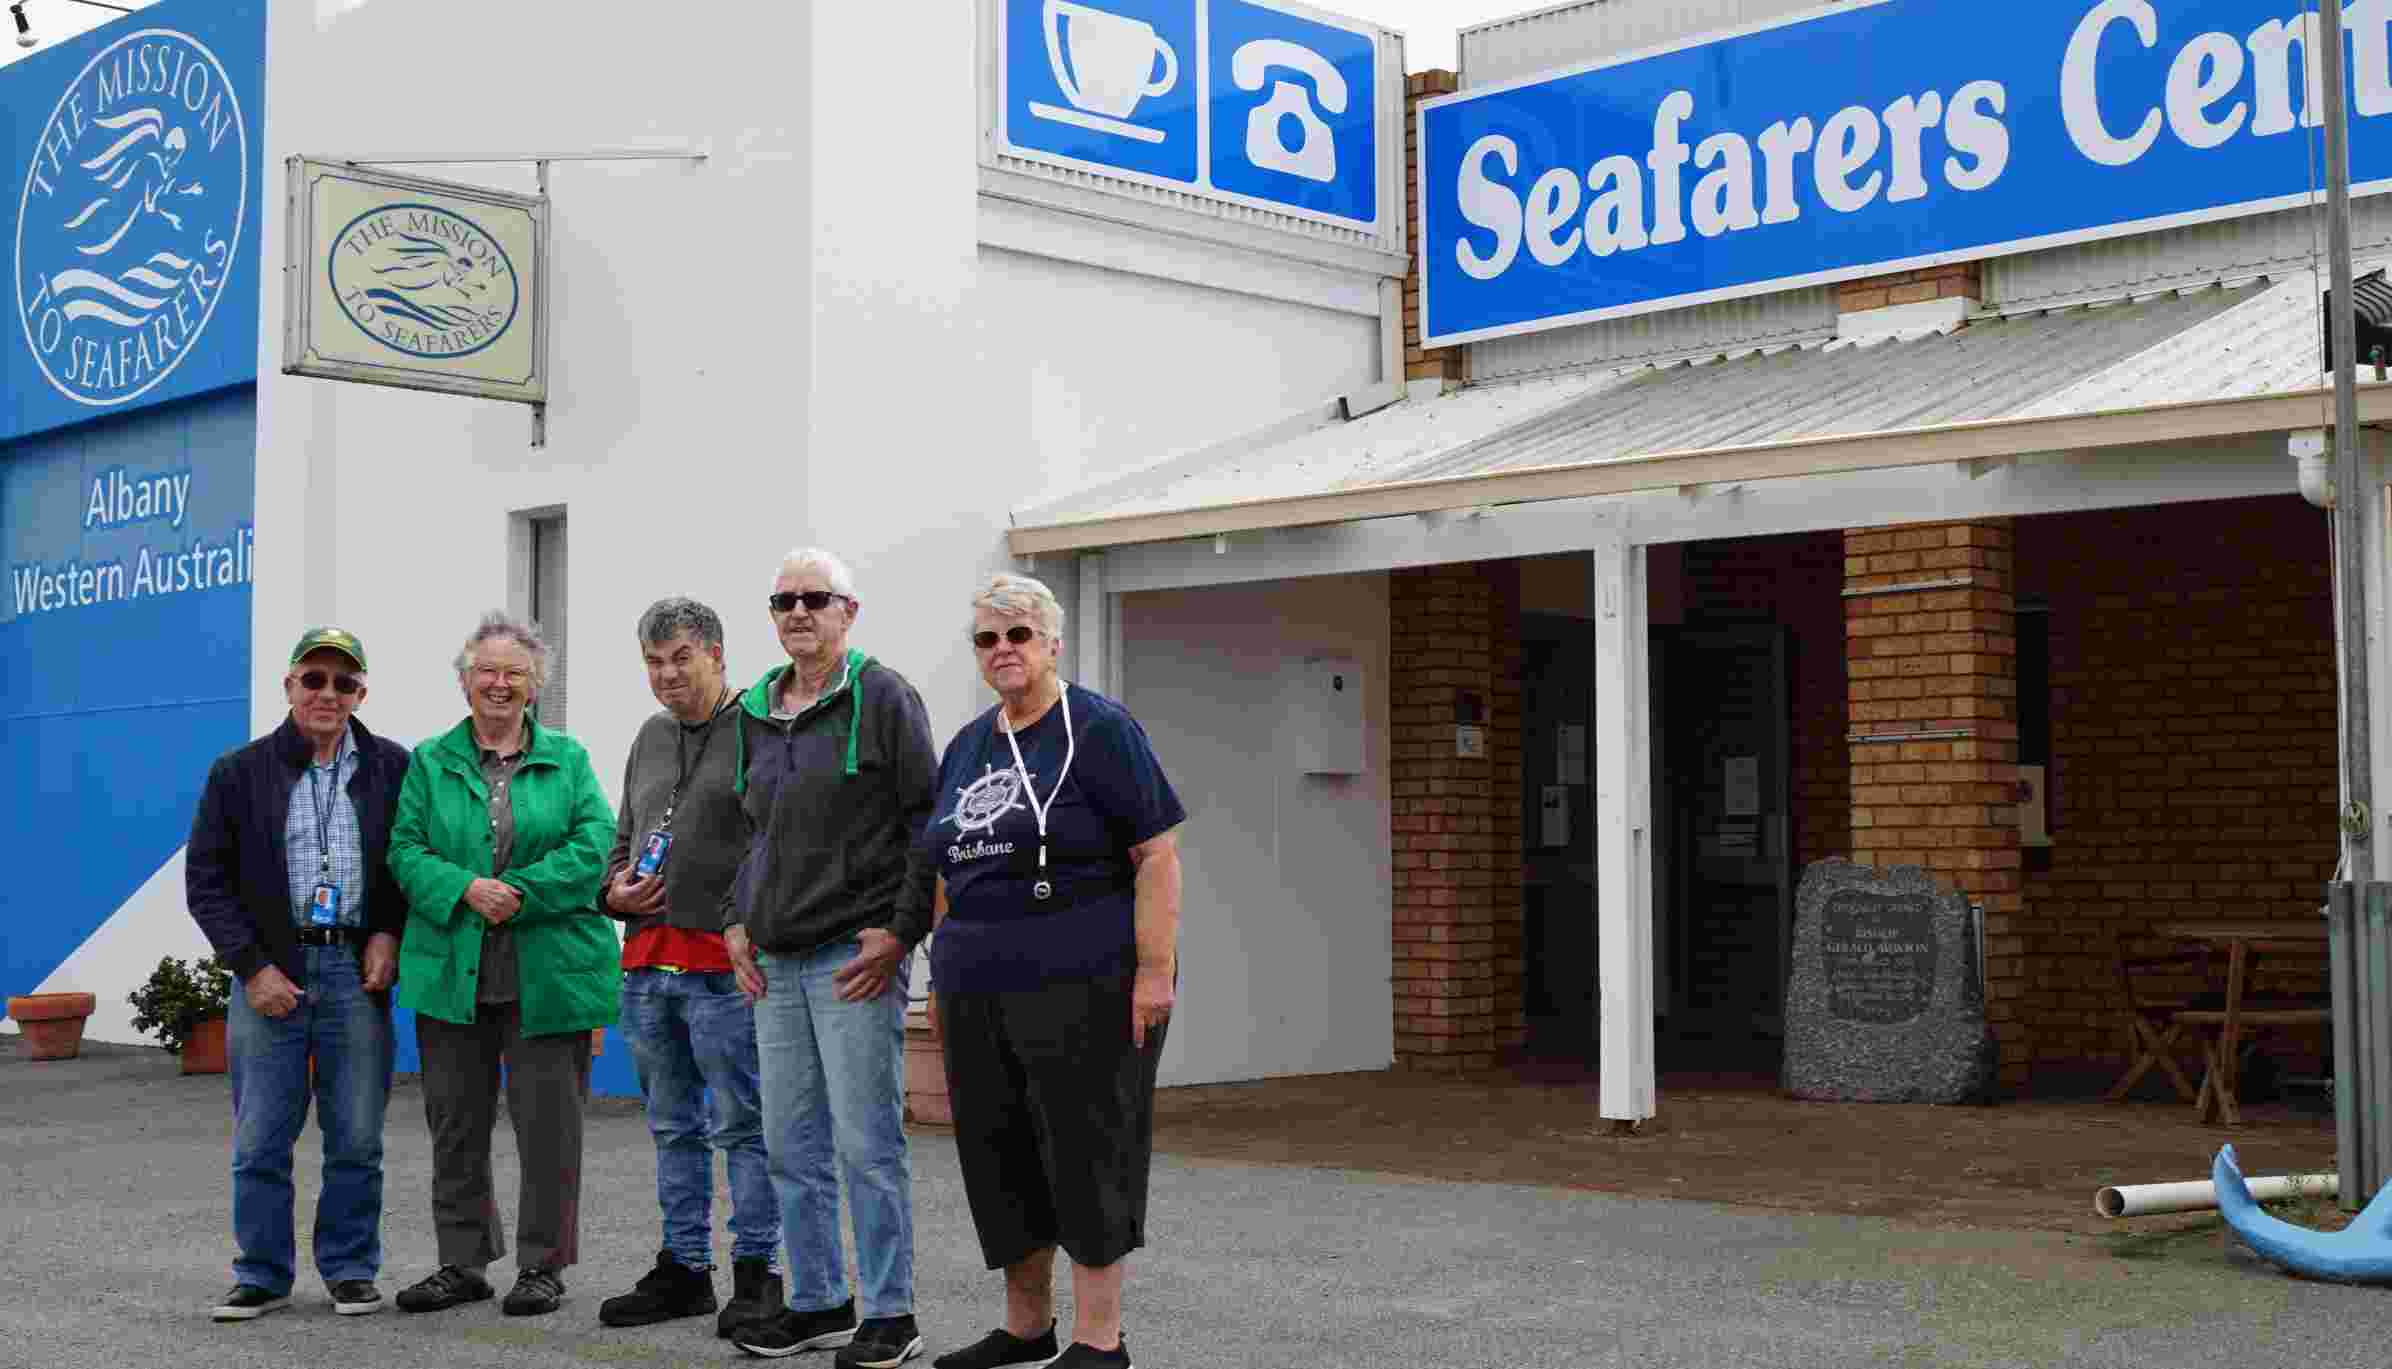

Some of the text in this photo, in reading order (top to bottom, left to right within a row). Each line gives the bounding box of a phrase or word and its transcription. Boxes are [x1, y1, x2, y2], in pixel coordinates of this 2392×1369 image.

[32, 43, 232, 196] THE MISSION
[1456, 80, 2009, 279] Seafarers
[343, 211, 505, 278] THE MISSION
[28, 228, 227, 390] TO SEAFARERS
[345, 284, 503, 352] TO SEAFARERS
[84, 469, 191, 527] Albany
[13, 562, 124, 614] Western
[947, 839, 1015, 863] Brisbane
